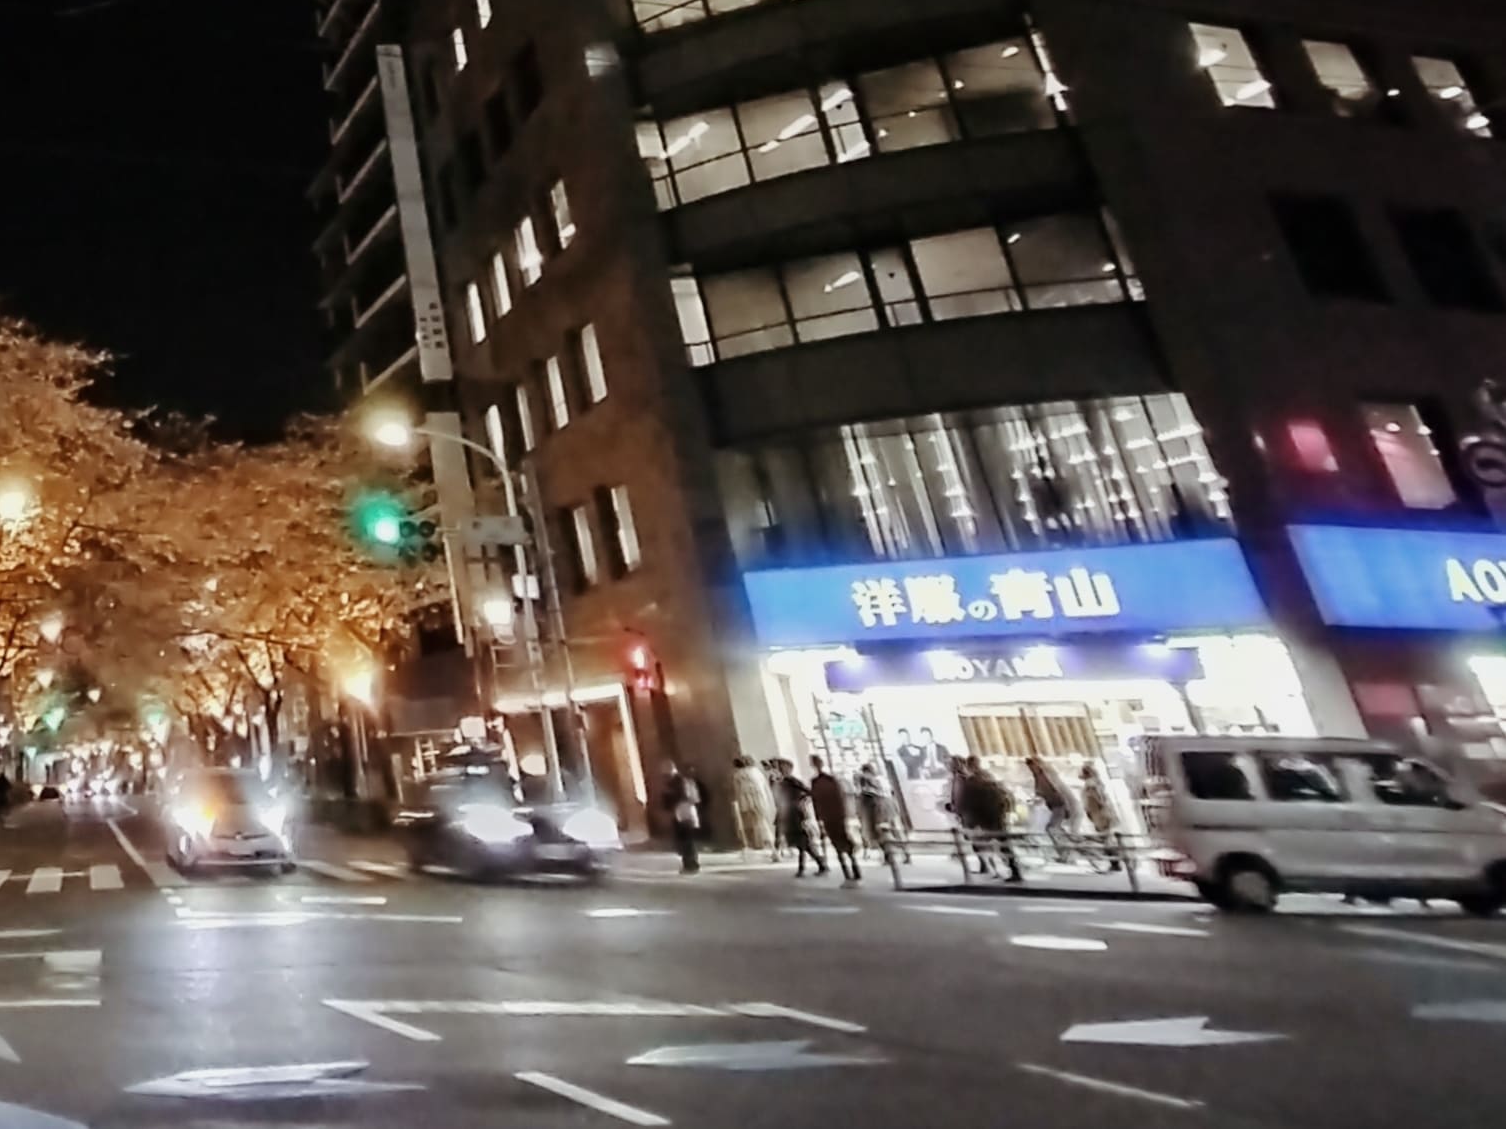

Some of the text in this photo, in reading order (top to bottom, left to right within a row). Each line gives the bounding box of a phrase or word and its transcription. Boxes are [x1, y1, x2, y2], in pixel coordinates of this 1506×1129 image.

[851, 567, 1121, 628] 洋服の青山
